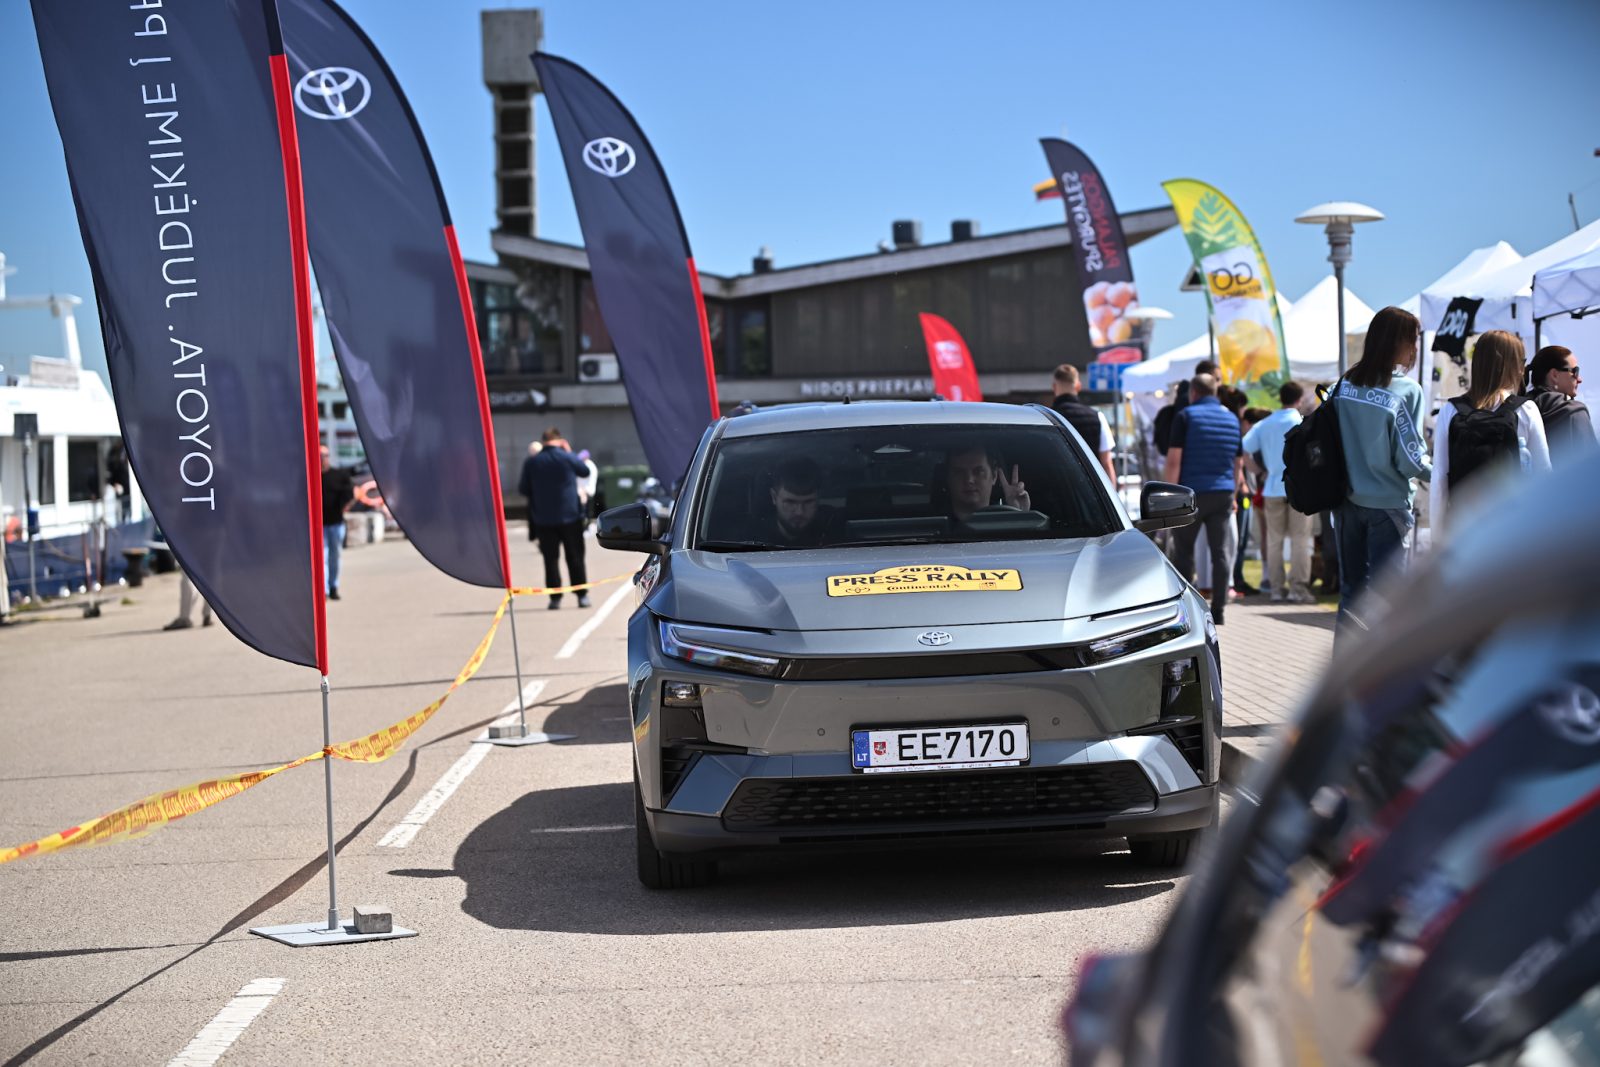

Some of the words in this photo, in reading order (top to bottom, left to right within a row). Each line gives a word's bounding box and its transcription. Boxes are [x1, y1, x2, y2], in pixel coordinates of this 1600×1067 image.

[801, 381, 855, 396] NIDOS
[857, 379, 935, 394] PRIEPLAU
[1341, 385, 1358, 397] lein
[833, 574, 919, 587] PRESS
[926, 572, 1009, 582] RALLY
[897, 729, 1015, 761] EE7170
[856, 753, 869, 762] LT
